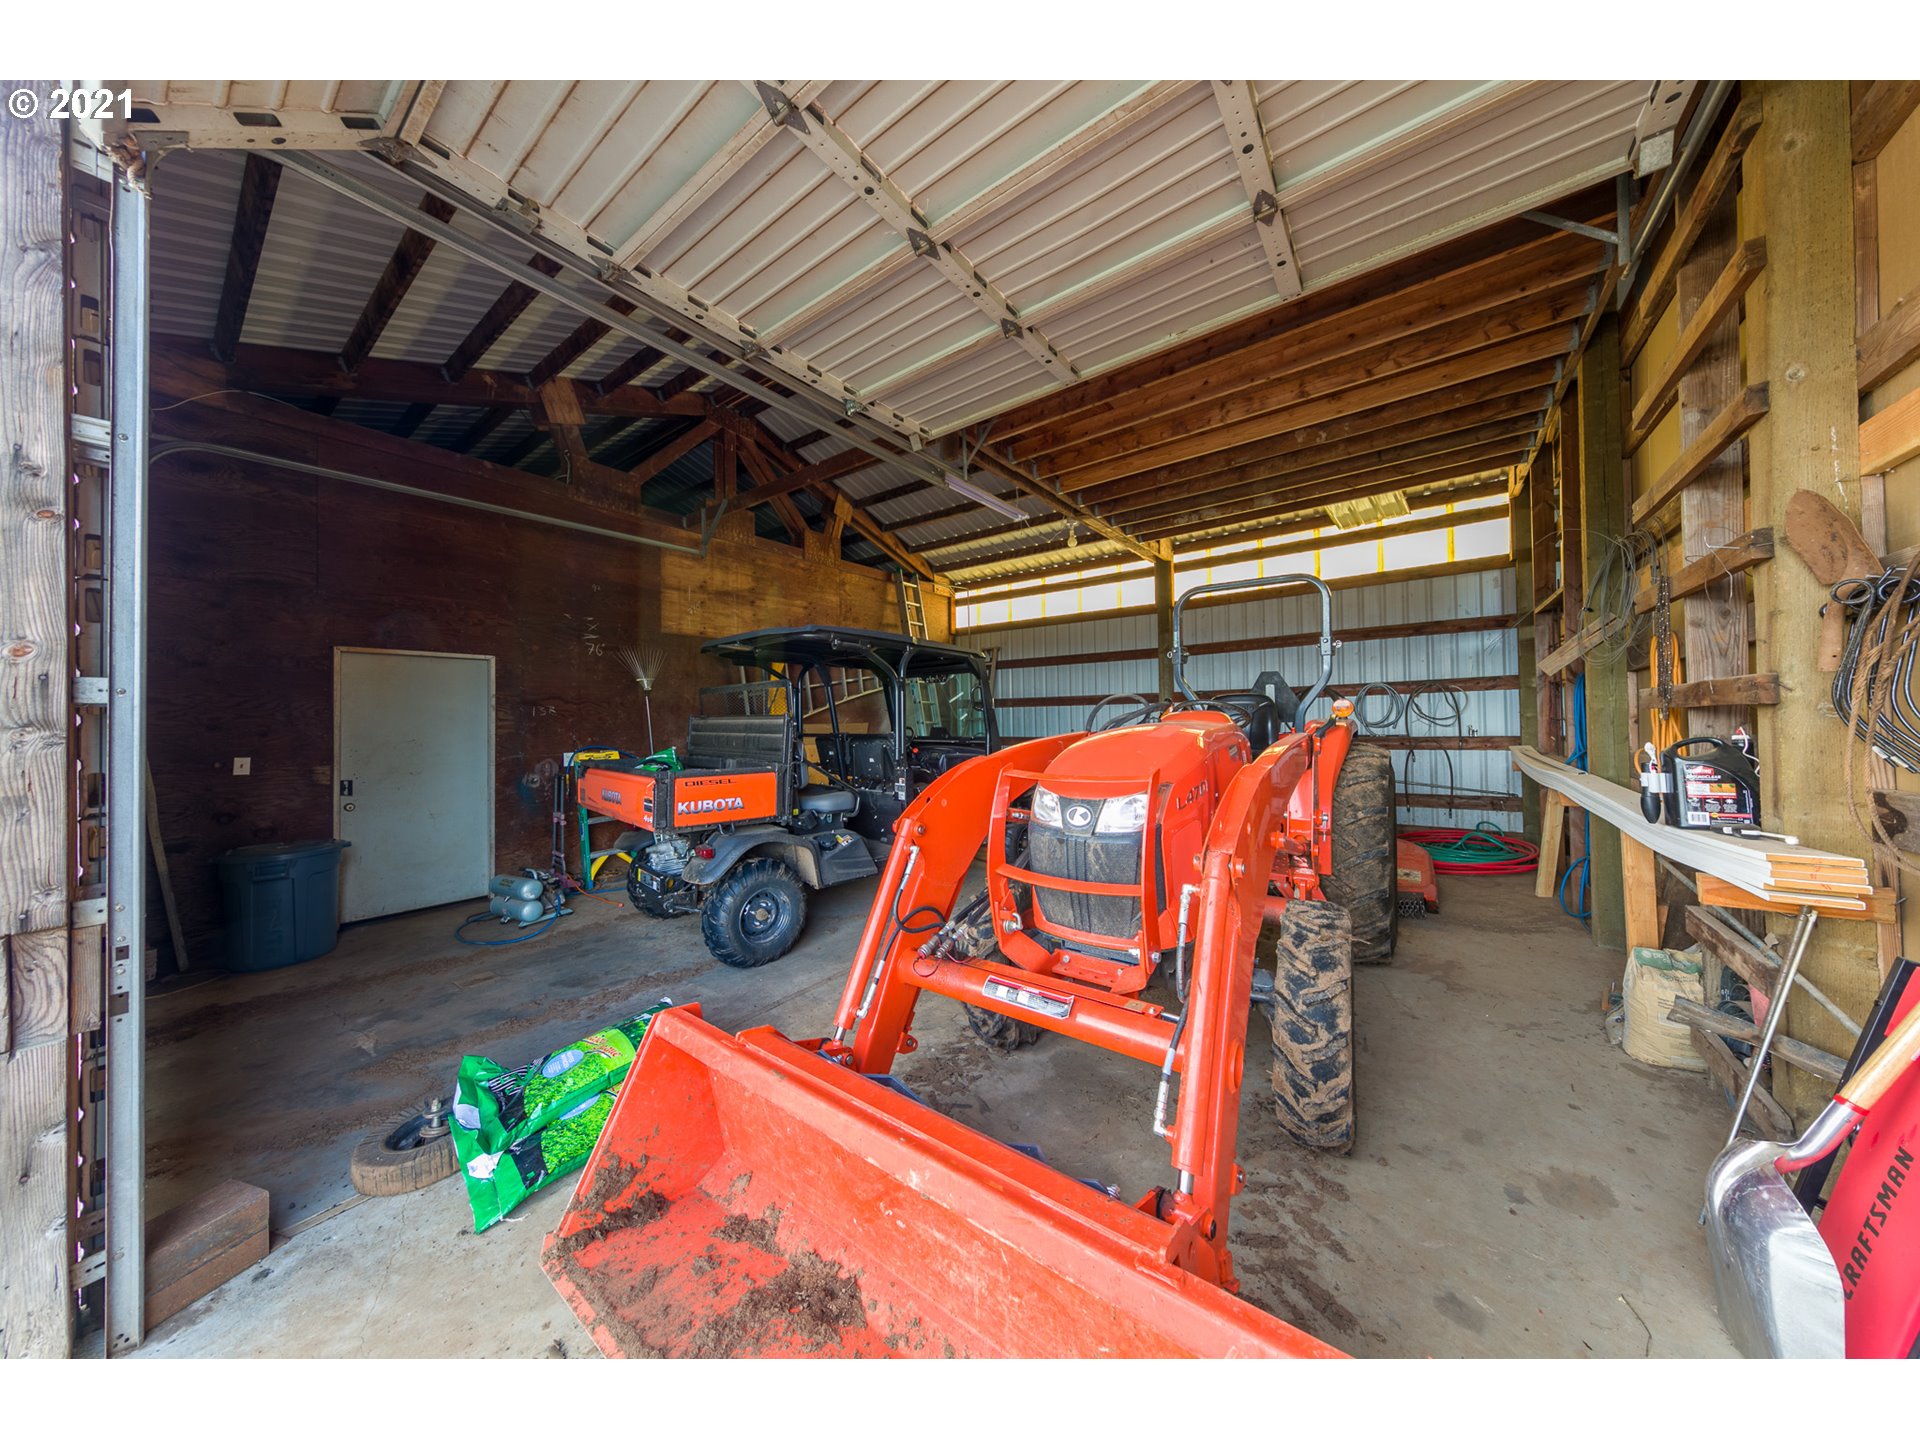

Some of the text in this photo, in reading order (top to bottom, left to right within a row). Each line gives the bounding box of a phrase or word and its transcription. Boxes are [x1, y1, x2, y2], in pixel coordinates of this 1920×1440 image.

[685, 777, 736, 788] DIESEL
[602, 788, 622, 805] KUBOTA
[677, 797, 744, 815] KUBOTA
